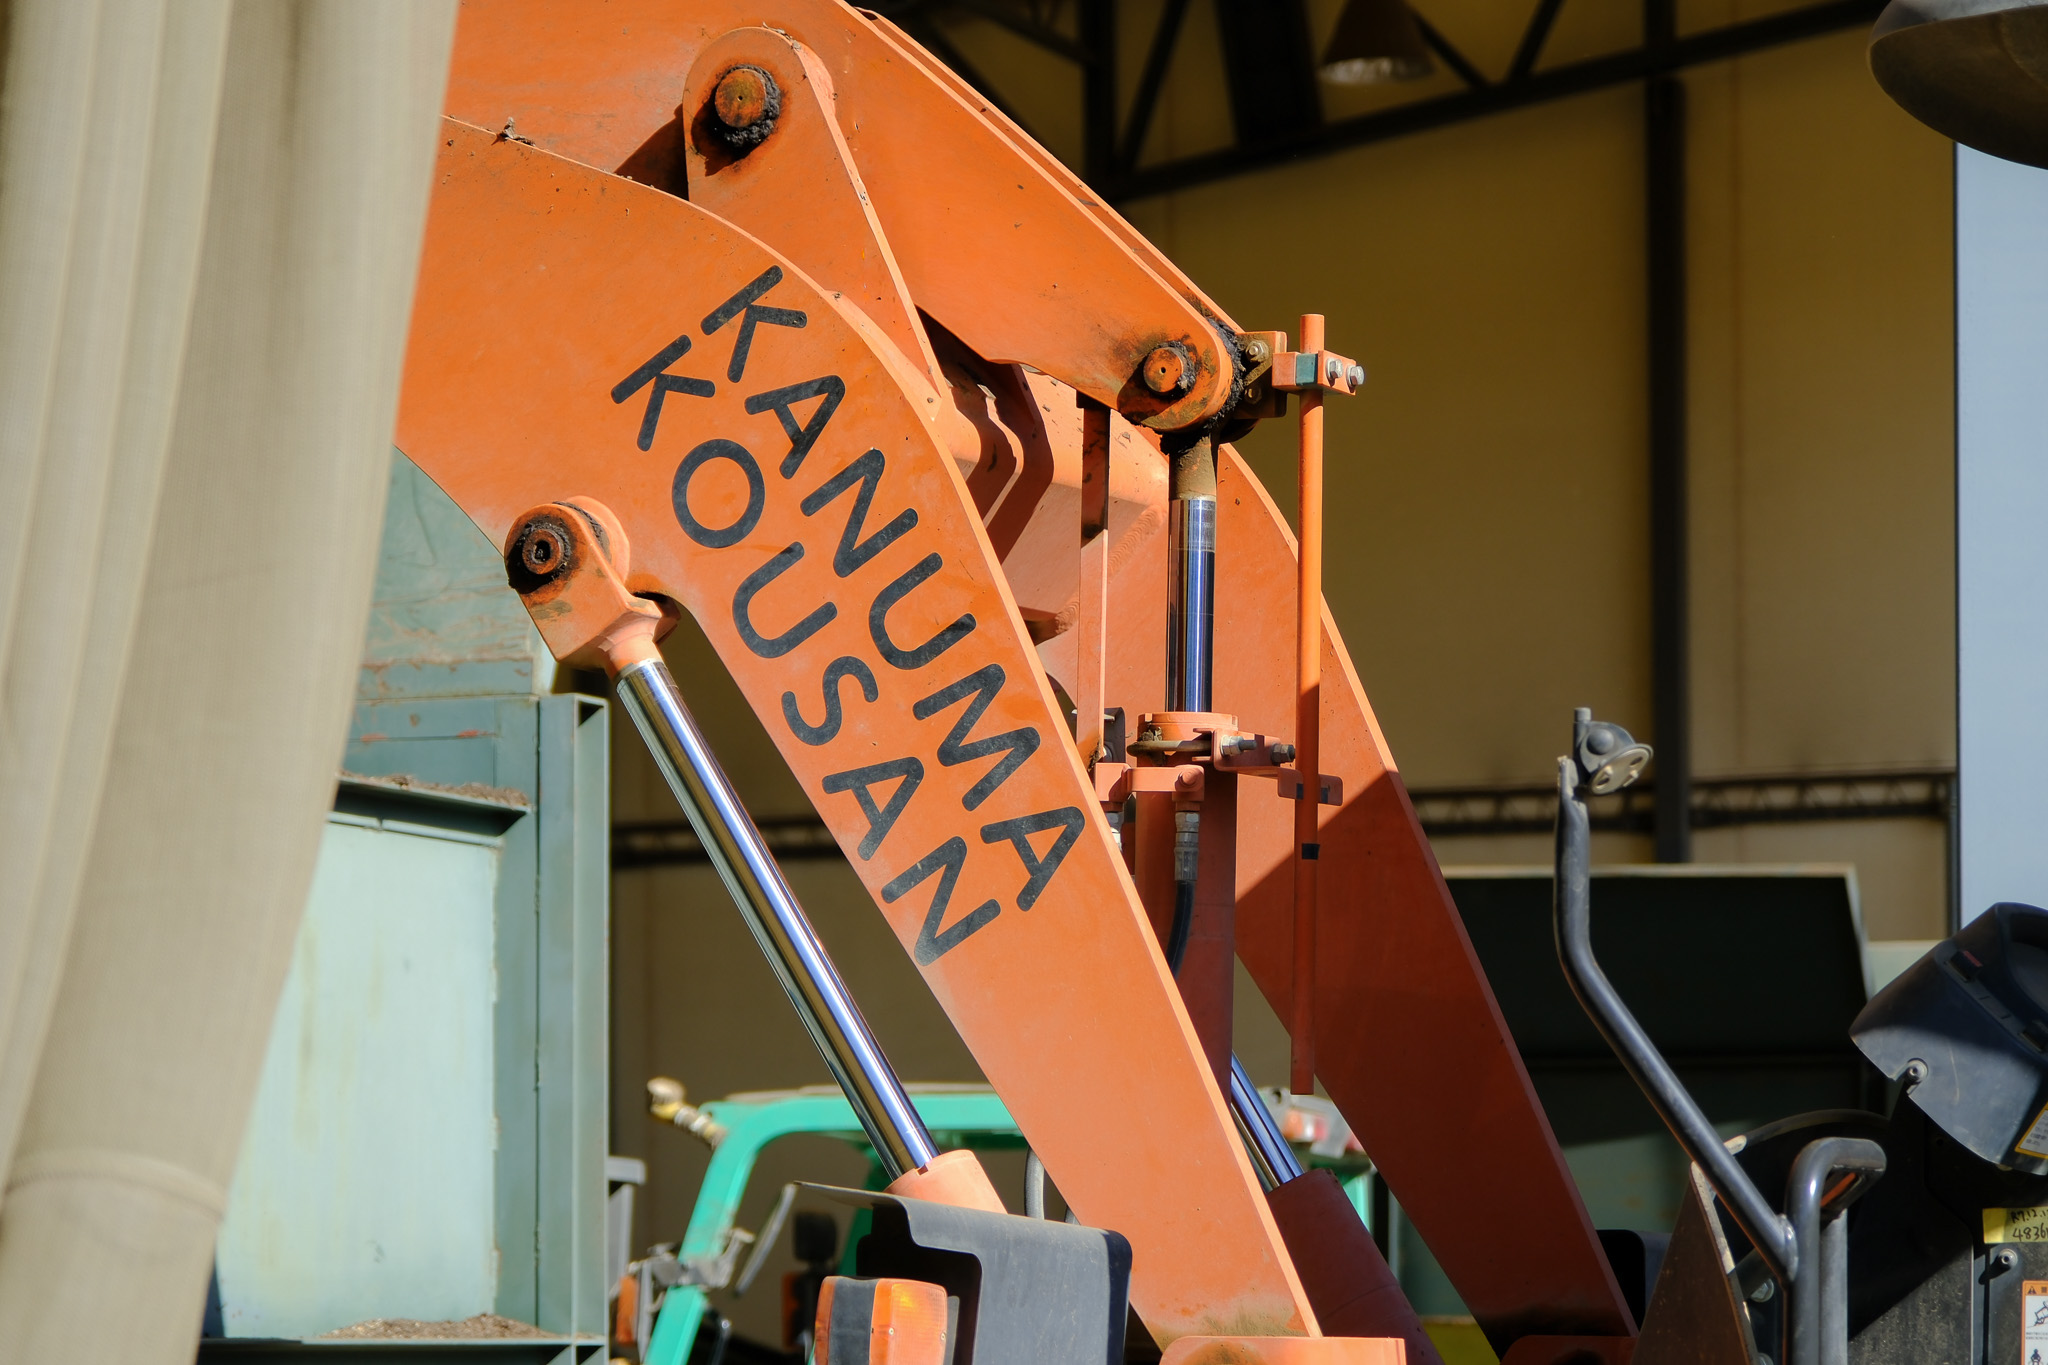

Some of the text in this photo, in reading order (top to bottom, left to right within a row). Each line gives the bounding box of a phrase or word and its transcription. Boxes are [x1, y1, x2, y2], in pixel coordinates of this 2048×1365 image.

[611, 334, 1001, 967] KOUSAN
[701, 265, 1085, 912] KANUMA
[2010, 1208, 2048, 1224] R7.12.1
[2012, 1222, 2048, 1242] 4836
